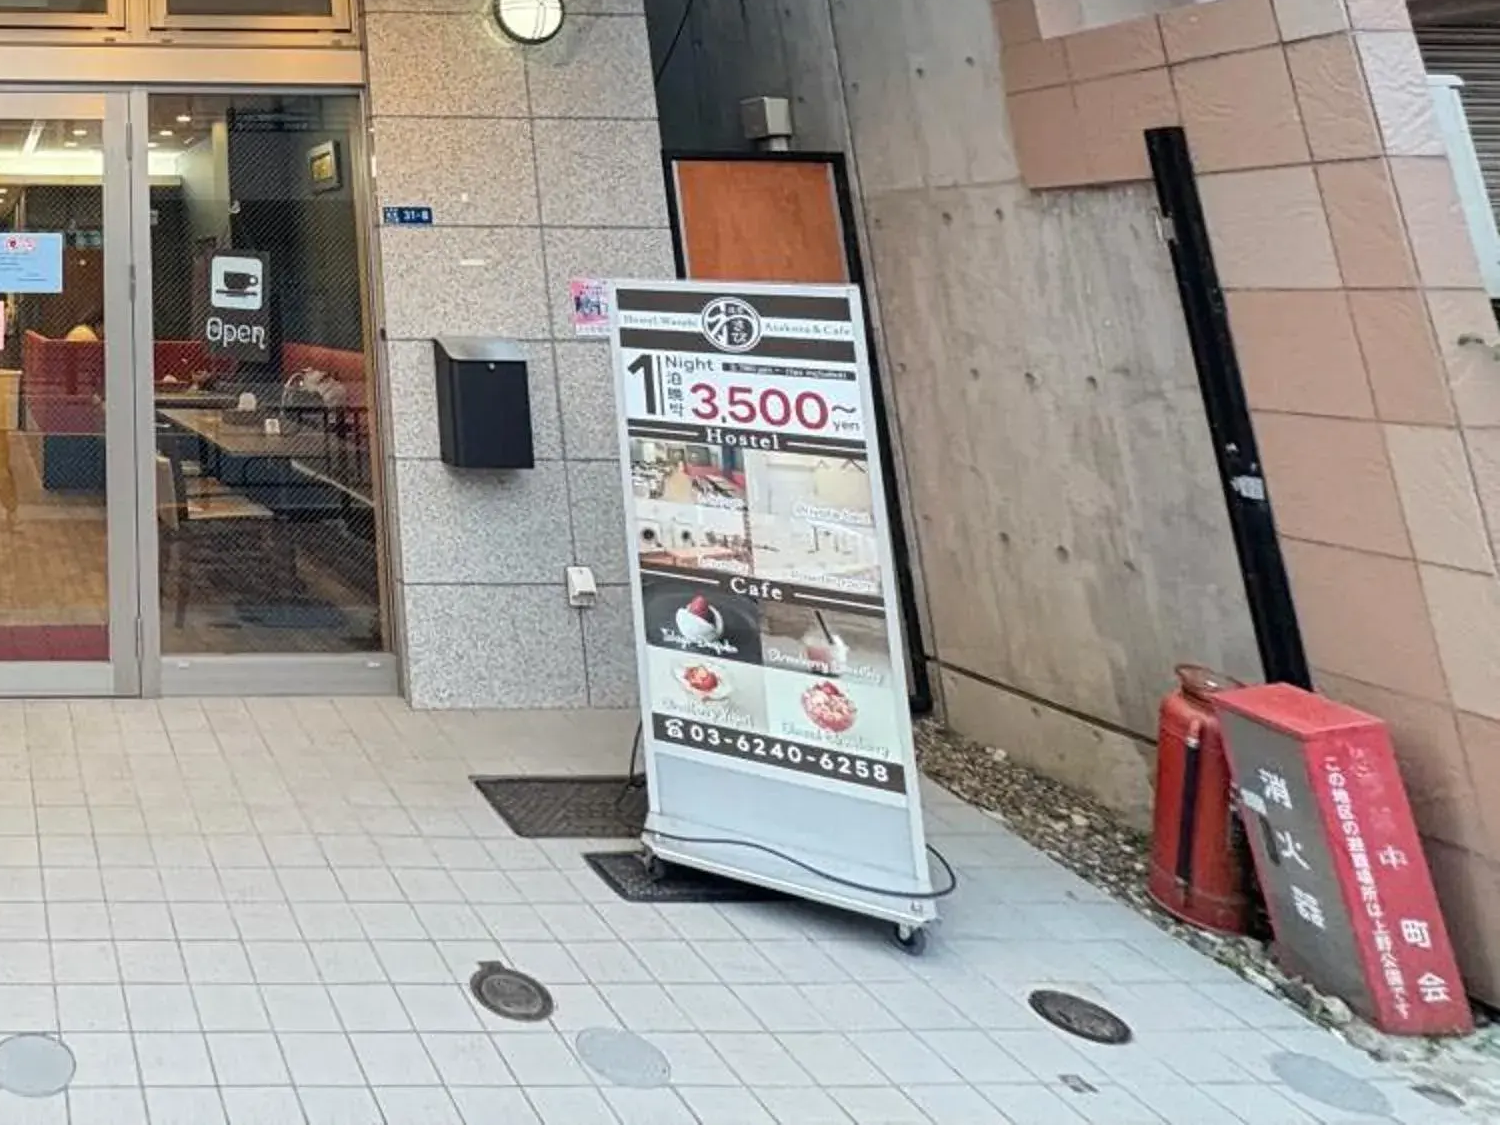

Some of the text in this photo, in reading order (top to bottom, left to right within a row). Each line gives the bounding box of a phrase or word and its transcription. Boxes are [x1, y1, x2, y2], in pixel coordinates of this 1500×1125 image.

[206, 317, 265, 349] Open
[627, 354, 714, 416] 1 Night
[705, 428, 780, 450] Hostel
[833, 421, 859, 431] yen
[730, 577, 784, 600] Cafe
[690, 721, 889, 783] 03-6240-6258
[1258, 767, 1326, 929] 消火器
